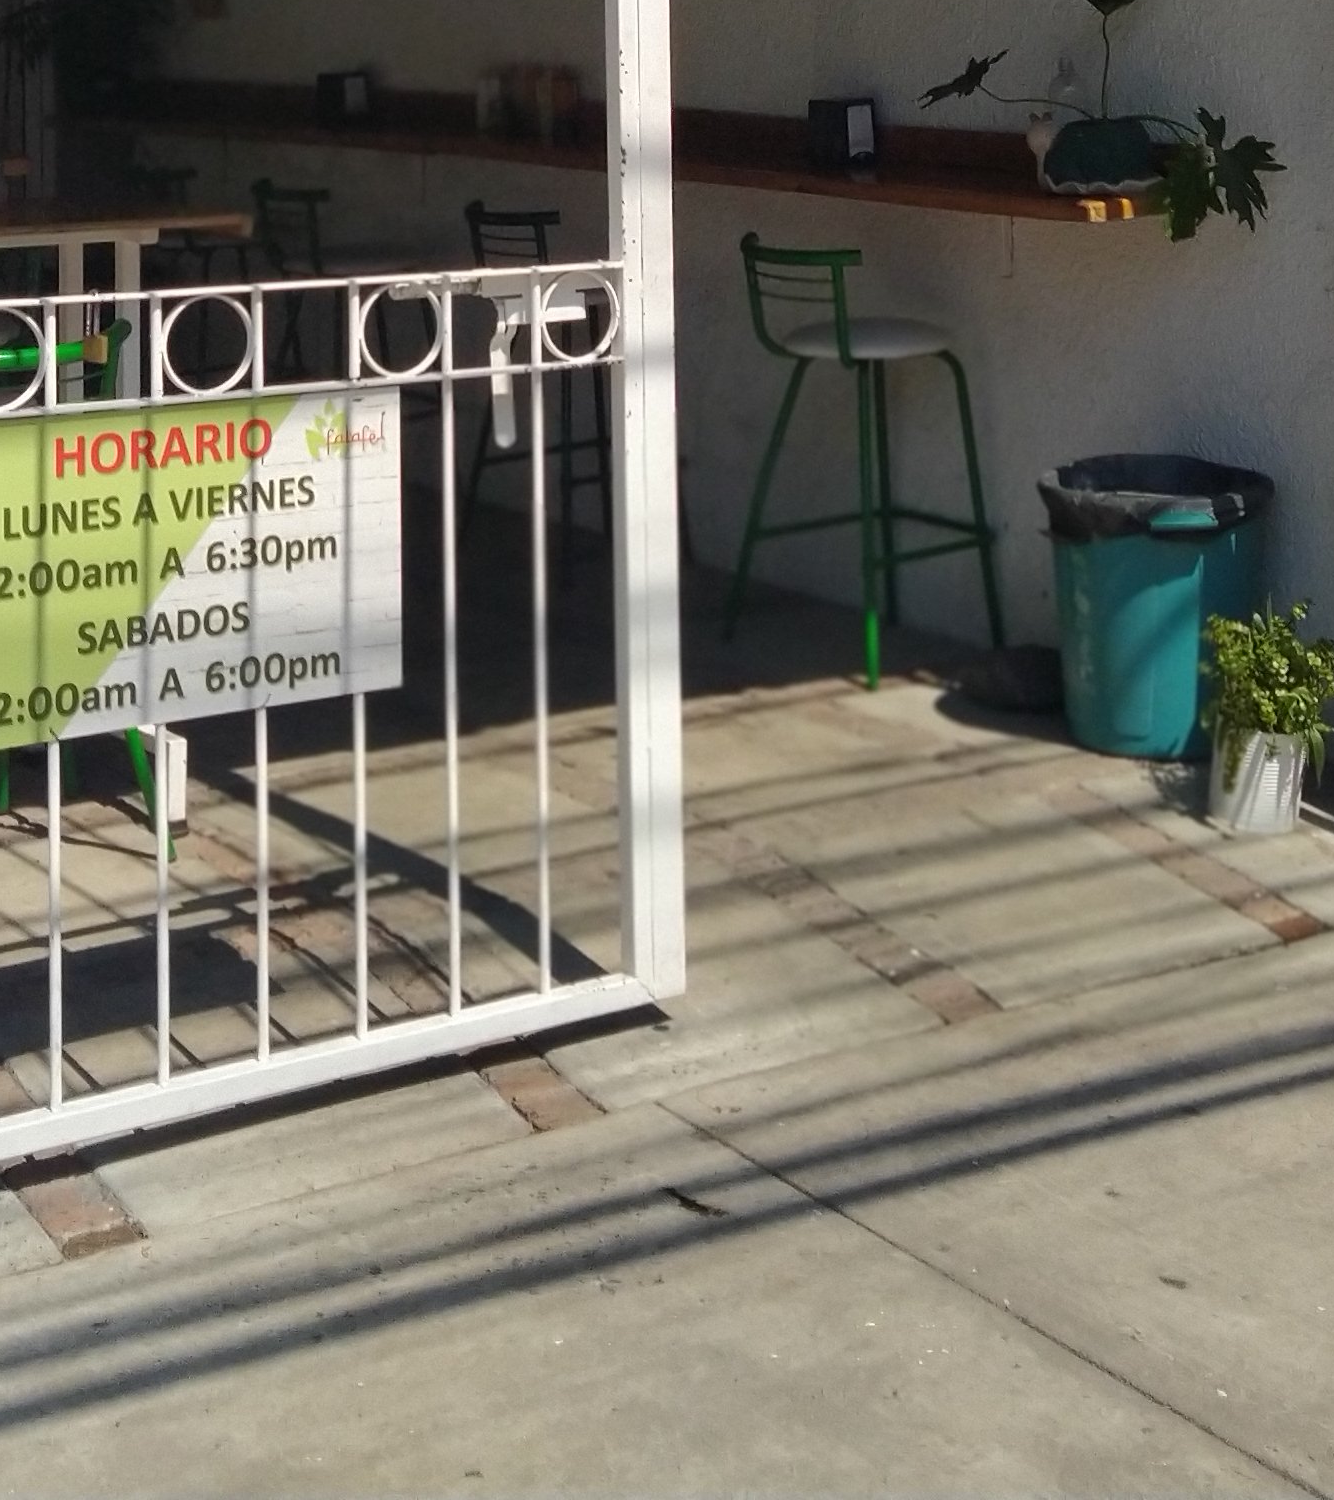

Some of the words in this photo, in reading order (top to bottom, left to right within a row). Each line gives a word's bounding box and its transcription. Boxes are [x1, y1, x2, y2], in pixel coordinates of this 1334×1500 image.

[53, 418, 273, 478] HORARIO
[3, 495, 121, 541] LUNES
[132, 492, 159, 525] A
[169, 475, 316, 521] VIERNES
[159, 547, 184, 581] A
[206, 533, 338, 576] 6:30pm
[77, 602, 251, 656] SABADOS
[159, 668, 184, 702] A
[204, 650, 341, 694] 6:00pm
